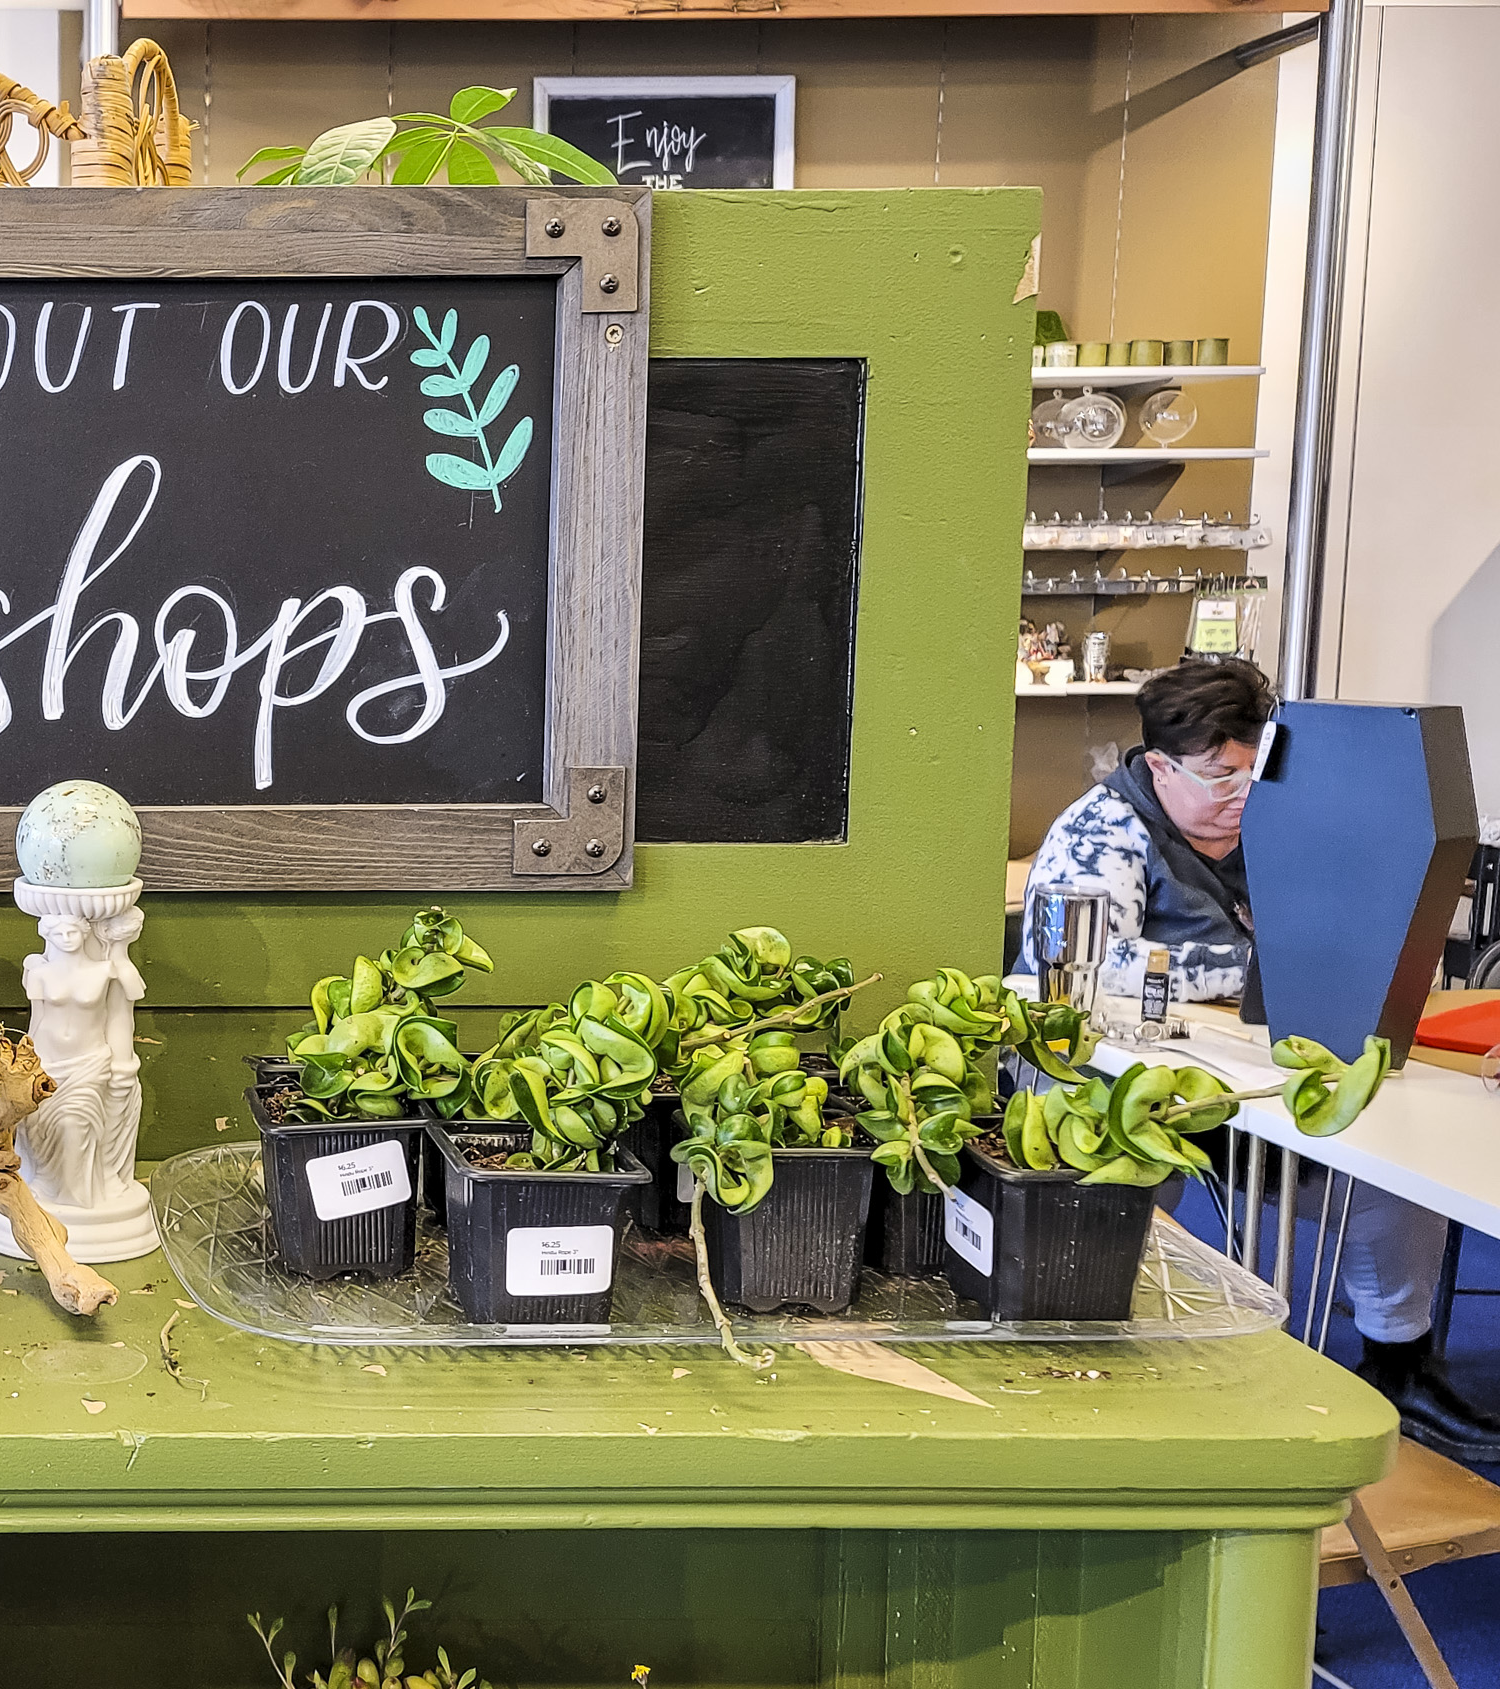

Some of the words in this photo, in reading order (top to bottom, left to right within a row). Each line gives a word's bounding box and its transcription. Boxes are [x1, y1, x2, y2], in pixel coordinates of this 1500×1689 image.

[606, 110, 707, 175] Enjoy
[641, 173, 684, 190] THE
[219, 300, 401, 395] OUR
[338, 1162, 356, 1170] $6.25
[541, 1240, 561, 1248] $6.25
